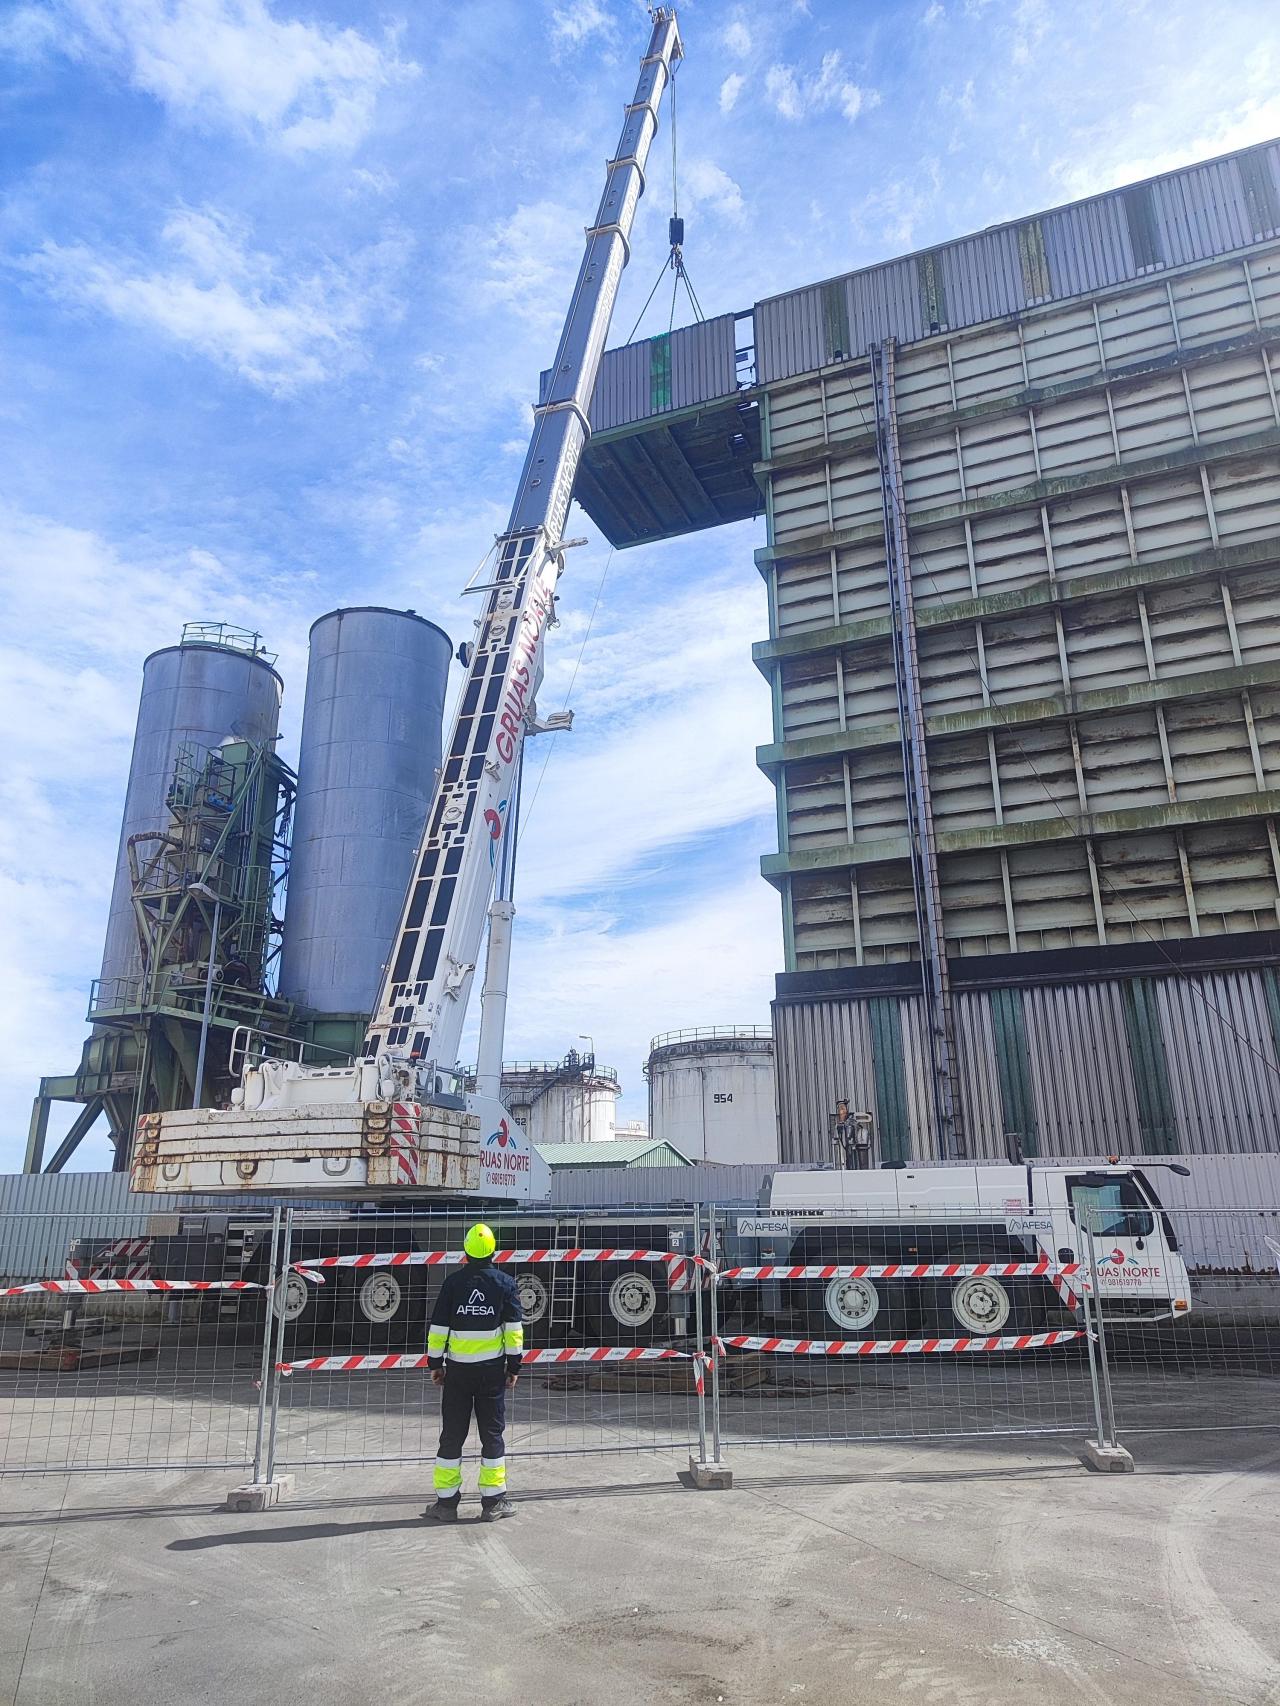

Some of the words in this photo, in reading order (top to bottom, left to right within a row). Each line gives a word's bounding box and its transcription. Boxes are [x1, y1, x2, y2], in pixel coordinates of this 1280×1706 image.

[496, 659, 530, 764] GRUAS
[713, 1093, 733, 1104] 954
[480, 1150, 502, 1169] RUAS
[503, 1153, 530, 1172] NORTE
[754, 1222, 789, 1232] AFESA
[1022, 1221, 1053, 1230] AFESA
[1122, 1267, 1161, 1278] NORTE
[456, 1304, 495, 1316] AFESA
